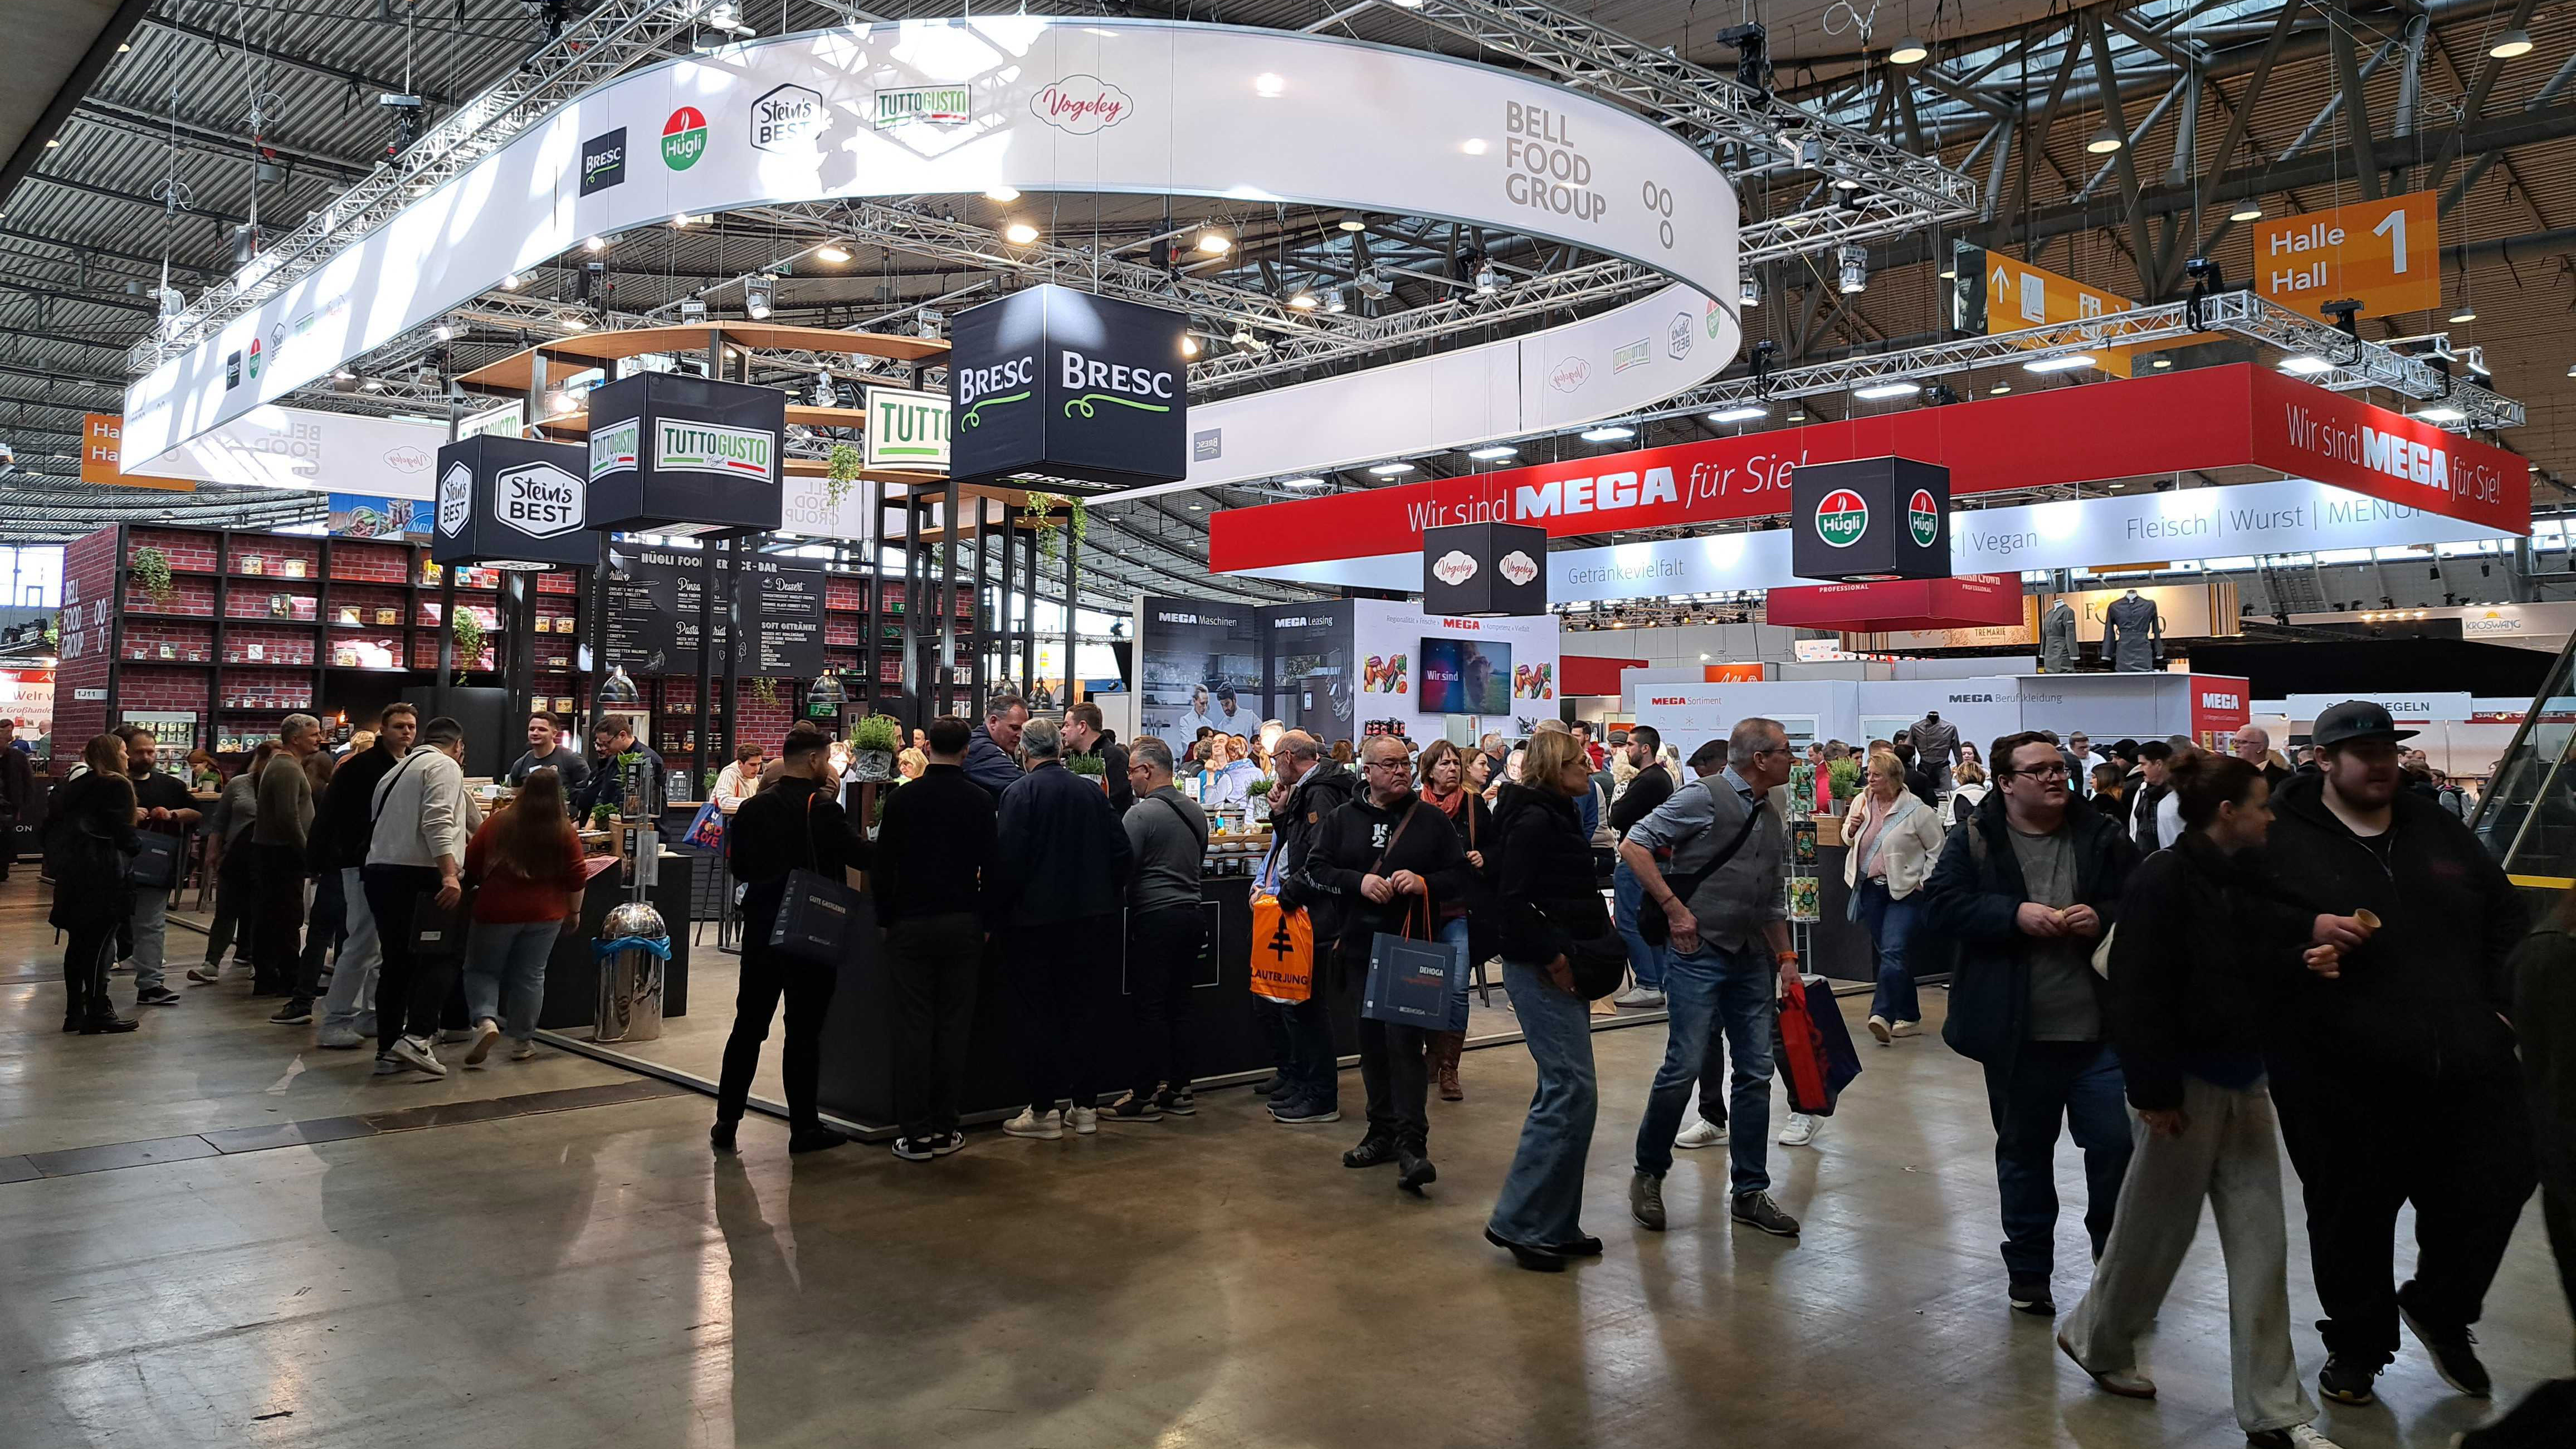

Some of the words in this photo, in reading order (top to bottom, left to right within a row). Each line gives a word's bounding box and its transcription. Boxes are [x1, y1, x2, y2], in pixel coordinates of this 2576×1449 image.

[760, 97, 812, 124] Stein's
[879, 90, 966, 118] TUTTOGUSTO
[1043, 88, 1123, 123] Vogeley
[1506, 100, 1574, 148] BELL
[667, 134, 702, 160] Hügli
[586, 147, 622, 174] BRESC
[1506, 136, 1592, 186] FOOD
[1505, 172, 1607, 224] GROUP
[2270, 225, 2345, 256] Halle
[2372, 209, 2408, 274] 1
[2271, 261, 2328, 295] Hall
[960, 357, 1033, 405] BRESC
[1062, 350, 1173, 399] BRESC
[593, 426, 636, 463] TUTTOGUSTO
[665, 427, 767, 466] TUTTOGUSTO
[2286, 403, 2317, 452] Wir
[2323, 417, 2359, 464] sind
[2363, 426, 2449, 491] MEGA
[2452, 456, 2473, 500] für
[2476, 461, 2501, 505] Sie!
[445, 477, 467, 504] Stein's
[511, 476, 573, 504] Stein's
[1006, 471, 1131, 490] BRESC
[1407, 500, 1447, 532] Wir
[1455, 487, 1507, 523] sind
[1515, 466, 1679, 519] MEGA
[1686, 461, 1735, 509] für
[1742, 449, 1808, 495] Sie!
[443, 502, 466, 523] BEST
[510, 502, 572, 524] BEST
[1823, 515, 1861, 535] Hügli
[1913, 514, 1934, 536] Hügli
[2126, 511, 2207, 541] Fleisch
[2231, 505, 2304, 532] Wurst
[1972, 531, 2037, 554] Vegan
[1438, 555, 1474, 579] Vogeley
[1504, 553, 1535, 578] Vogeley
[1568, 558, 1685, 586] Getränkevielfalt
[65, 578, 80, 606] BELL
[677, 577, 701, 591] Pinsa
[775, 578, 806, 591] Dessert
[1819, 583, 1869, 593] PROFESSIONAL
[1962, 583, 1992, 593] PROFESSIONAL
[1978, 574, 2001, 585] Crown
[63, 606, 82, 633] FOOD
[676, 621, 700, 635] Pasta
[761, 621, 779, 630] SOFT
[1159, 612, 1197, 625] MEGA
[1198, 614, 1237, 627] Maschinen
[1275, 617, 1307, 628] MEGA
[1308, 614, 1333, 627] Leasing
[1387, 615, 1415, 623] Regionalität
[1443, 618, 1480, 630] MEGA
[2466, 619, 2521, 630] KROSWANG
[62, 632, 84, 660] GROUP
[1426, 670, 1440, 681] Wir
[1440, 670, 1458, 681] sind
[1652, 697, 1686, 705] MEGA
[1687, 696, 1721, 705] Sortiment
[1949, 694, 1993, 703] MEGA
[1996, 692, 2062, 704] Berufkleidung
[2202, 692, 2240, 710] MEGA
[7, 706, 53, 716] Großhande
